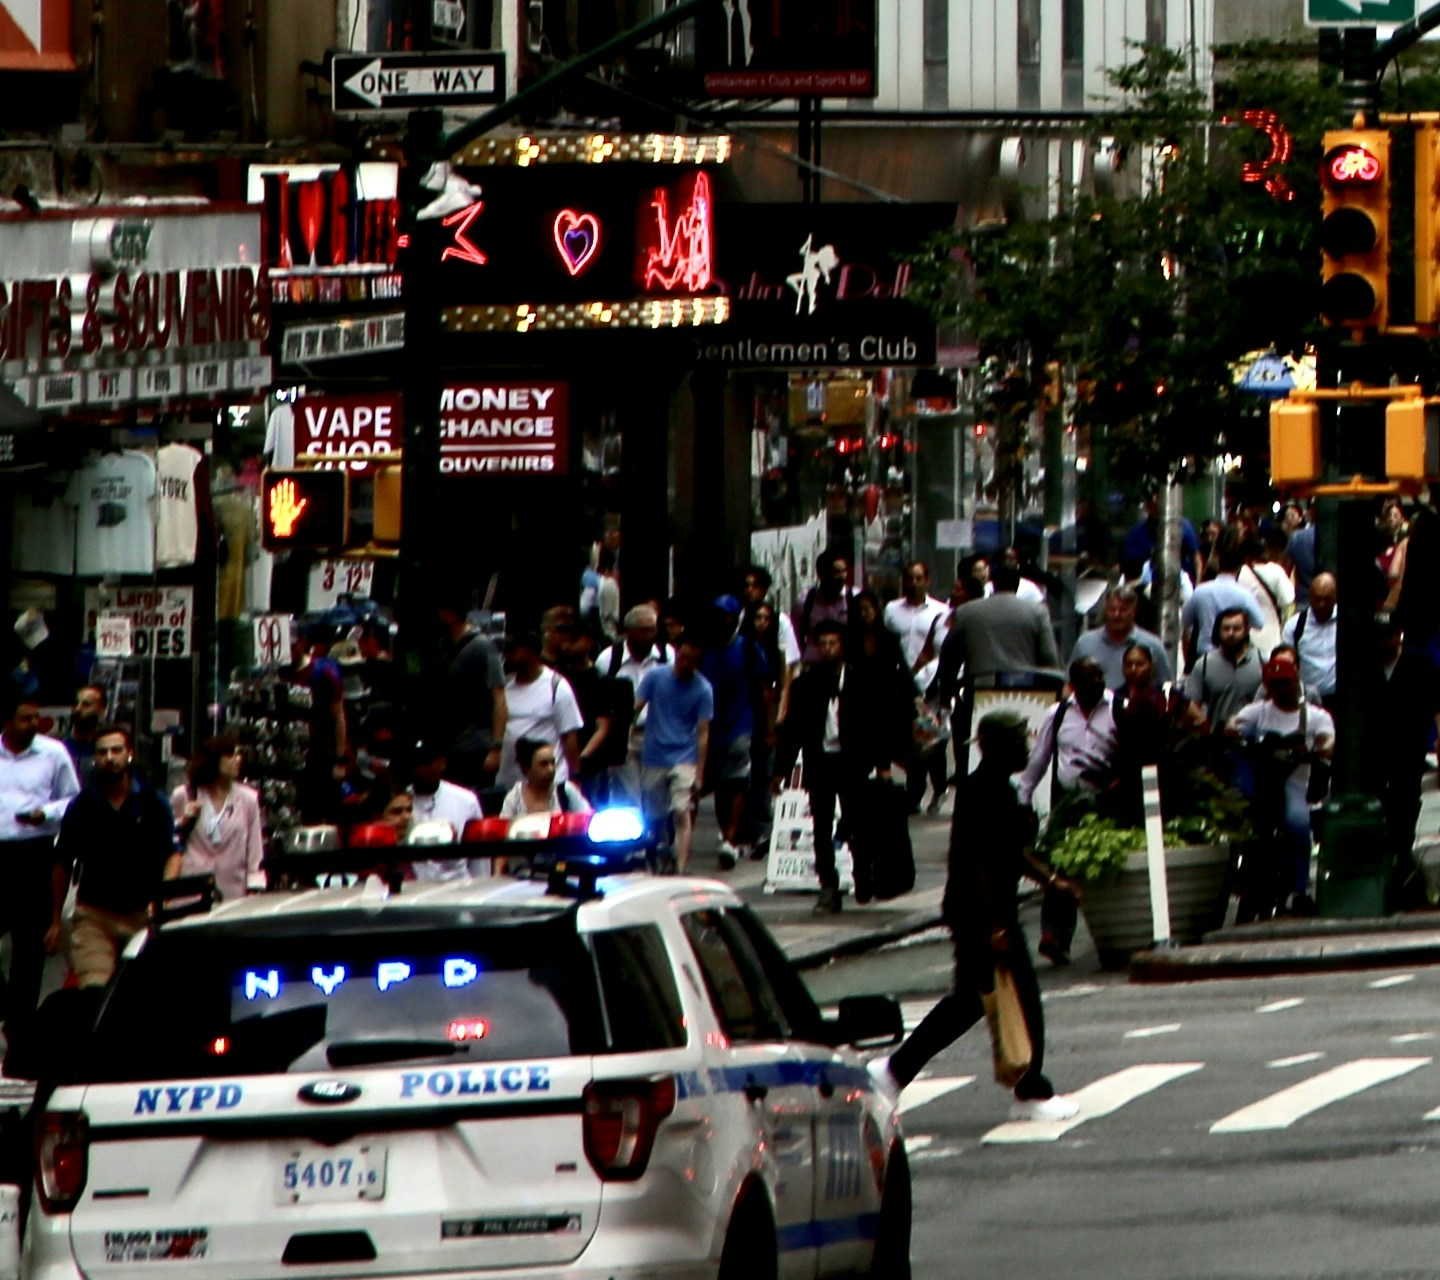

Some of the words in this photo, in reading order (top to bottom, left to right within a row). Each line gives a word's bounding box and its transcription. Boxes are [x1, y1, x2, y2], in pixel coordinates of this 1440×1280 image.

[361, 71, 409, 94] ONE
[433, 70, 484, 91] WAY
[768, 73, 791, 87] Club
[794, 74, 813, 87] and
[849, 73, 867, 86] Bar
[835, 263, 913, 301] Doll
[82, 272, 101, 354] &
[113, 264, 273, 352] SOUVENIRS
[860, 336, 917, 361] Club
[305, 406, 392, 438] VAPE
[441, 417, 554, 438] HANGE
[440, 456, 554, 473] OUVENIRS
[168, 607, 187, 626] of
[134, 1083, 244, 1115] NYPD
[400, 1065, 552, 1099] POLICE
[283, 1159, 354, 1190] 5407
